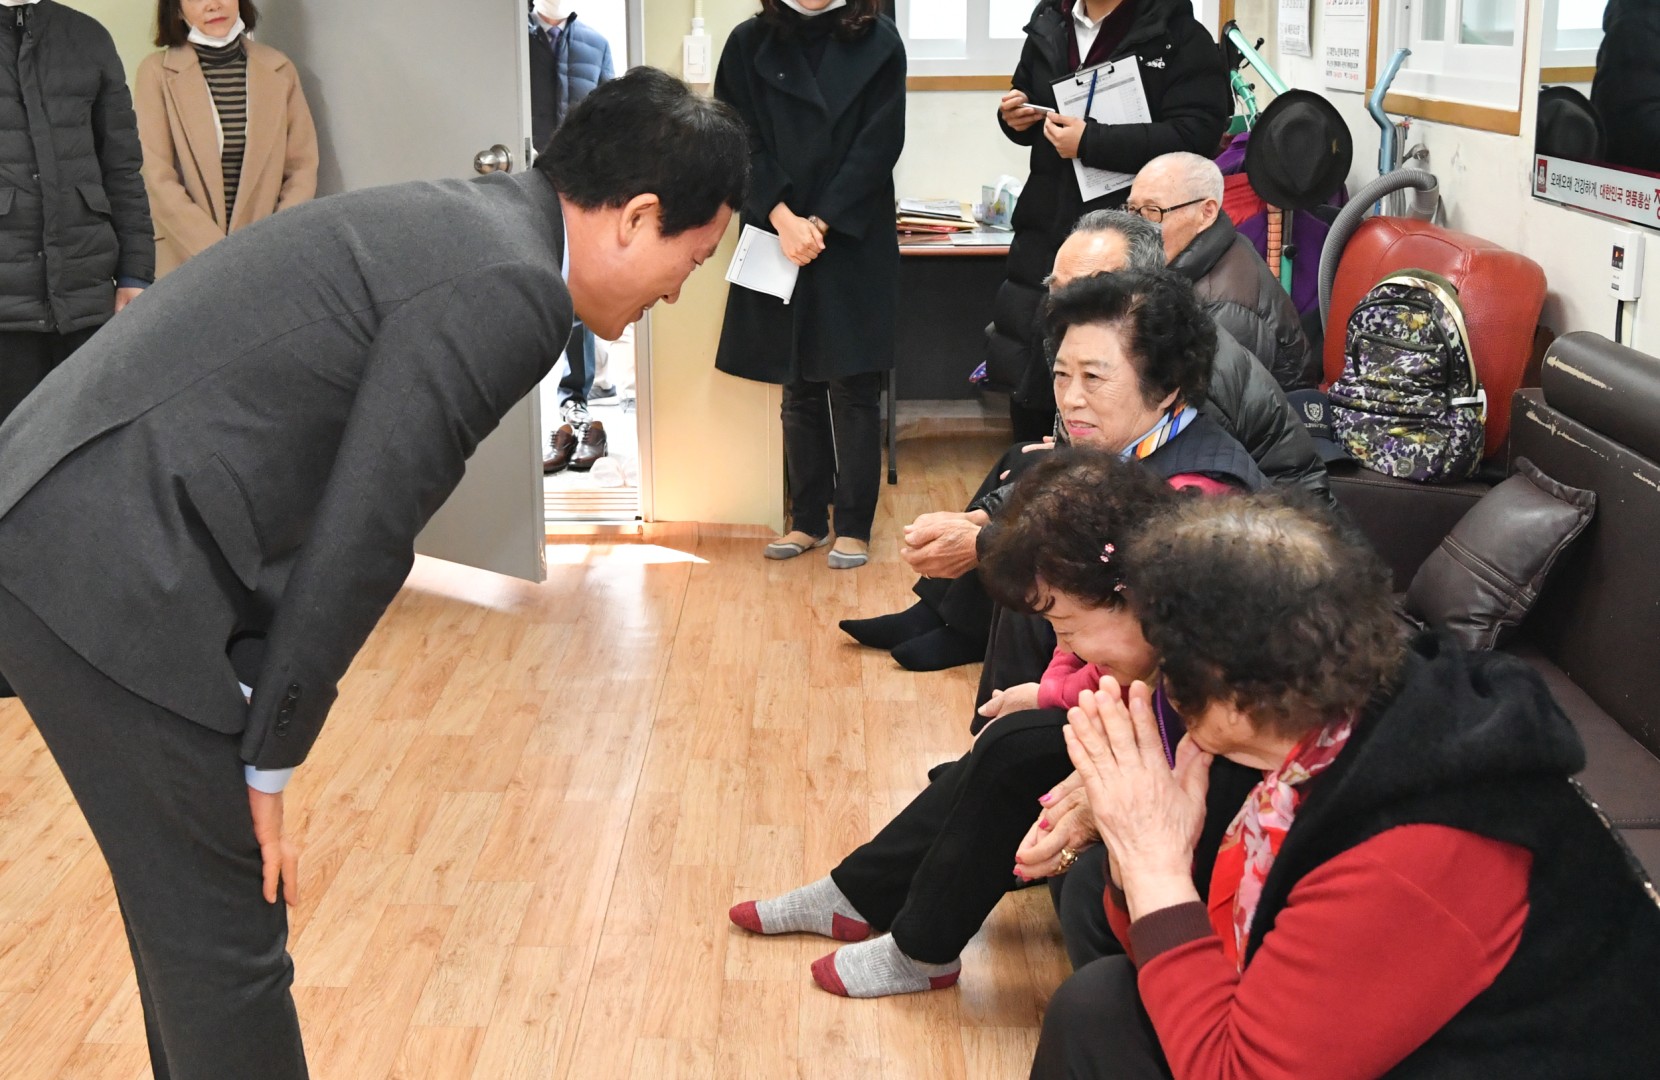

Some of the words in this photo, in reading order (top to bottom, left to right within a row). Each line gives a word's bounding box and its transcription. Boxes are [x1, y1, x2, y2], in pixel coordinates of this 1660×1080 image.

[1550, 173, 1572, 190] 오래오래
[1600, 184, 1623, 203] 대한민국
[1626, 189, 1651, 210] 명품홍삼
